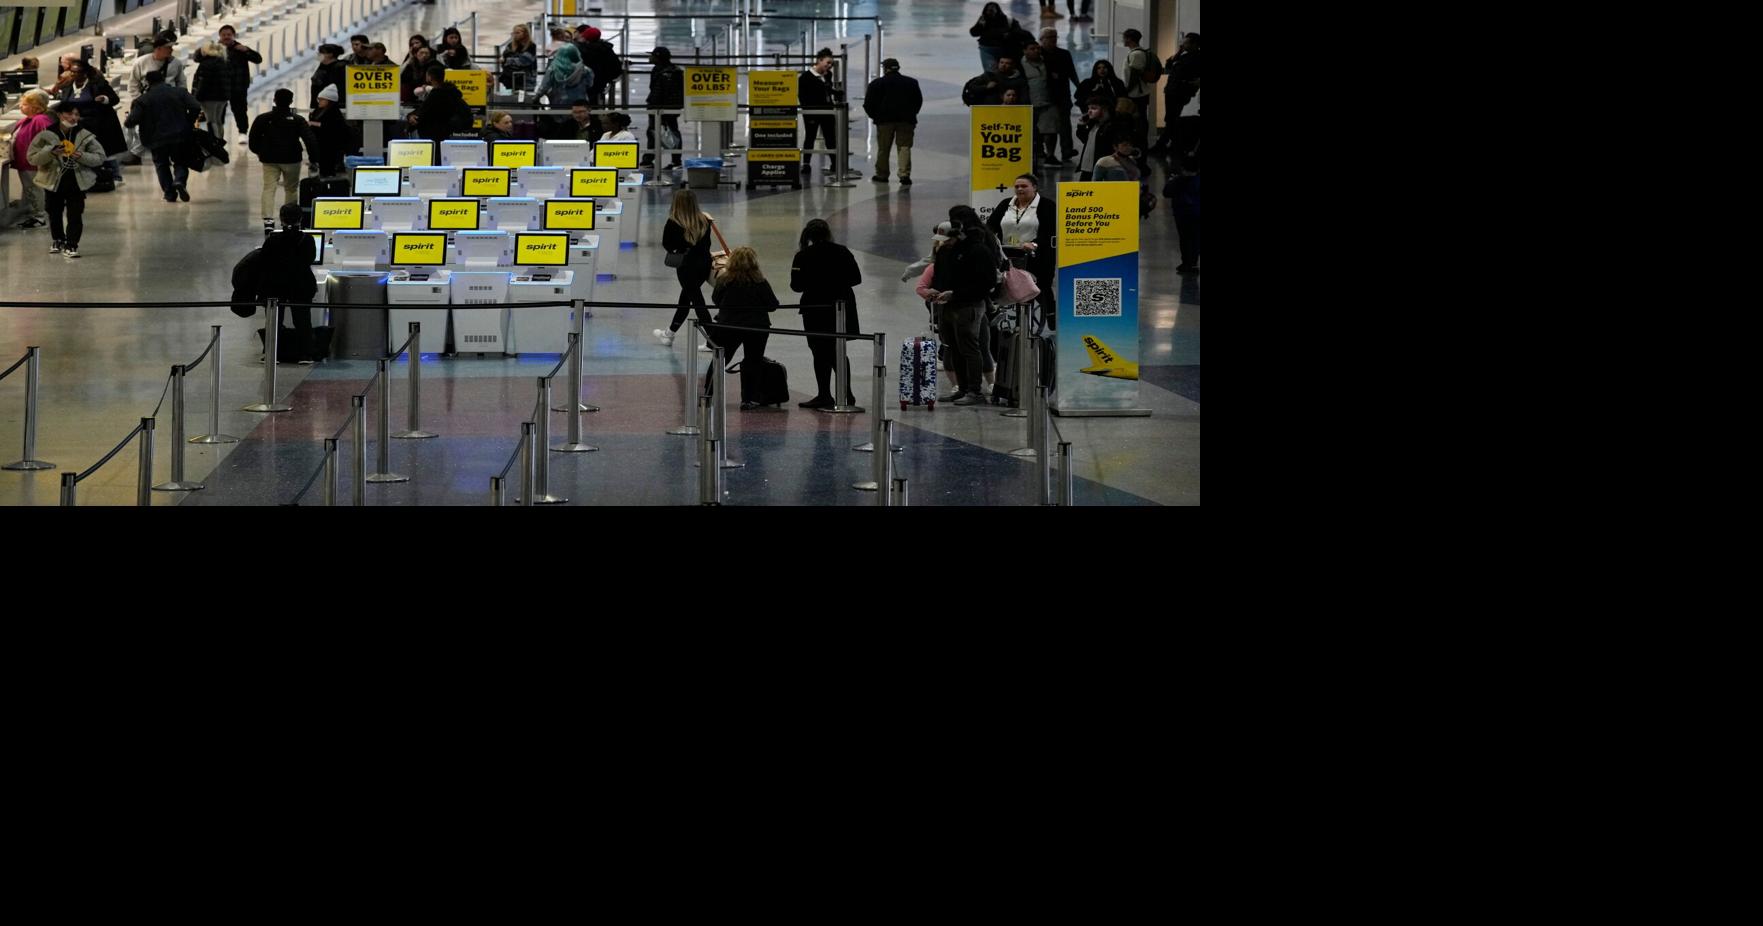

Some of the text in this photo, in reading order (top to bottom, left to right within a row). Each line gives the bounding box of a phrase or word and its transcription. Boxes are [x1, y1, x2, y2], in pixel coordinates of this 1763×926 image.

[353, 71, 393, 81] OVER
[691, 73, 730, 82] OVER
[691, 83, 731, 91] 40 LBS?
[981, 123, 1022, 132] Self-Tag
[980, 131, 1023, 143] Your
[981, 145, 1022, 162] Bag
[1065, 189, 1094, 198] spirit
[323, 208, 352, 216] spirit
[439, 208, 468, 216] spirit
[554, 208, 584, 216] spirit
[1093, 212, 1120, 220] Points
[403, 243, 435, 251] spirit
[526, 243, 557, 251] spirit
[1083, 336, 1114, 364] spirit
